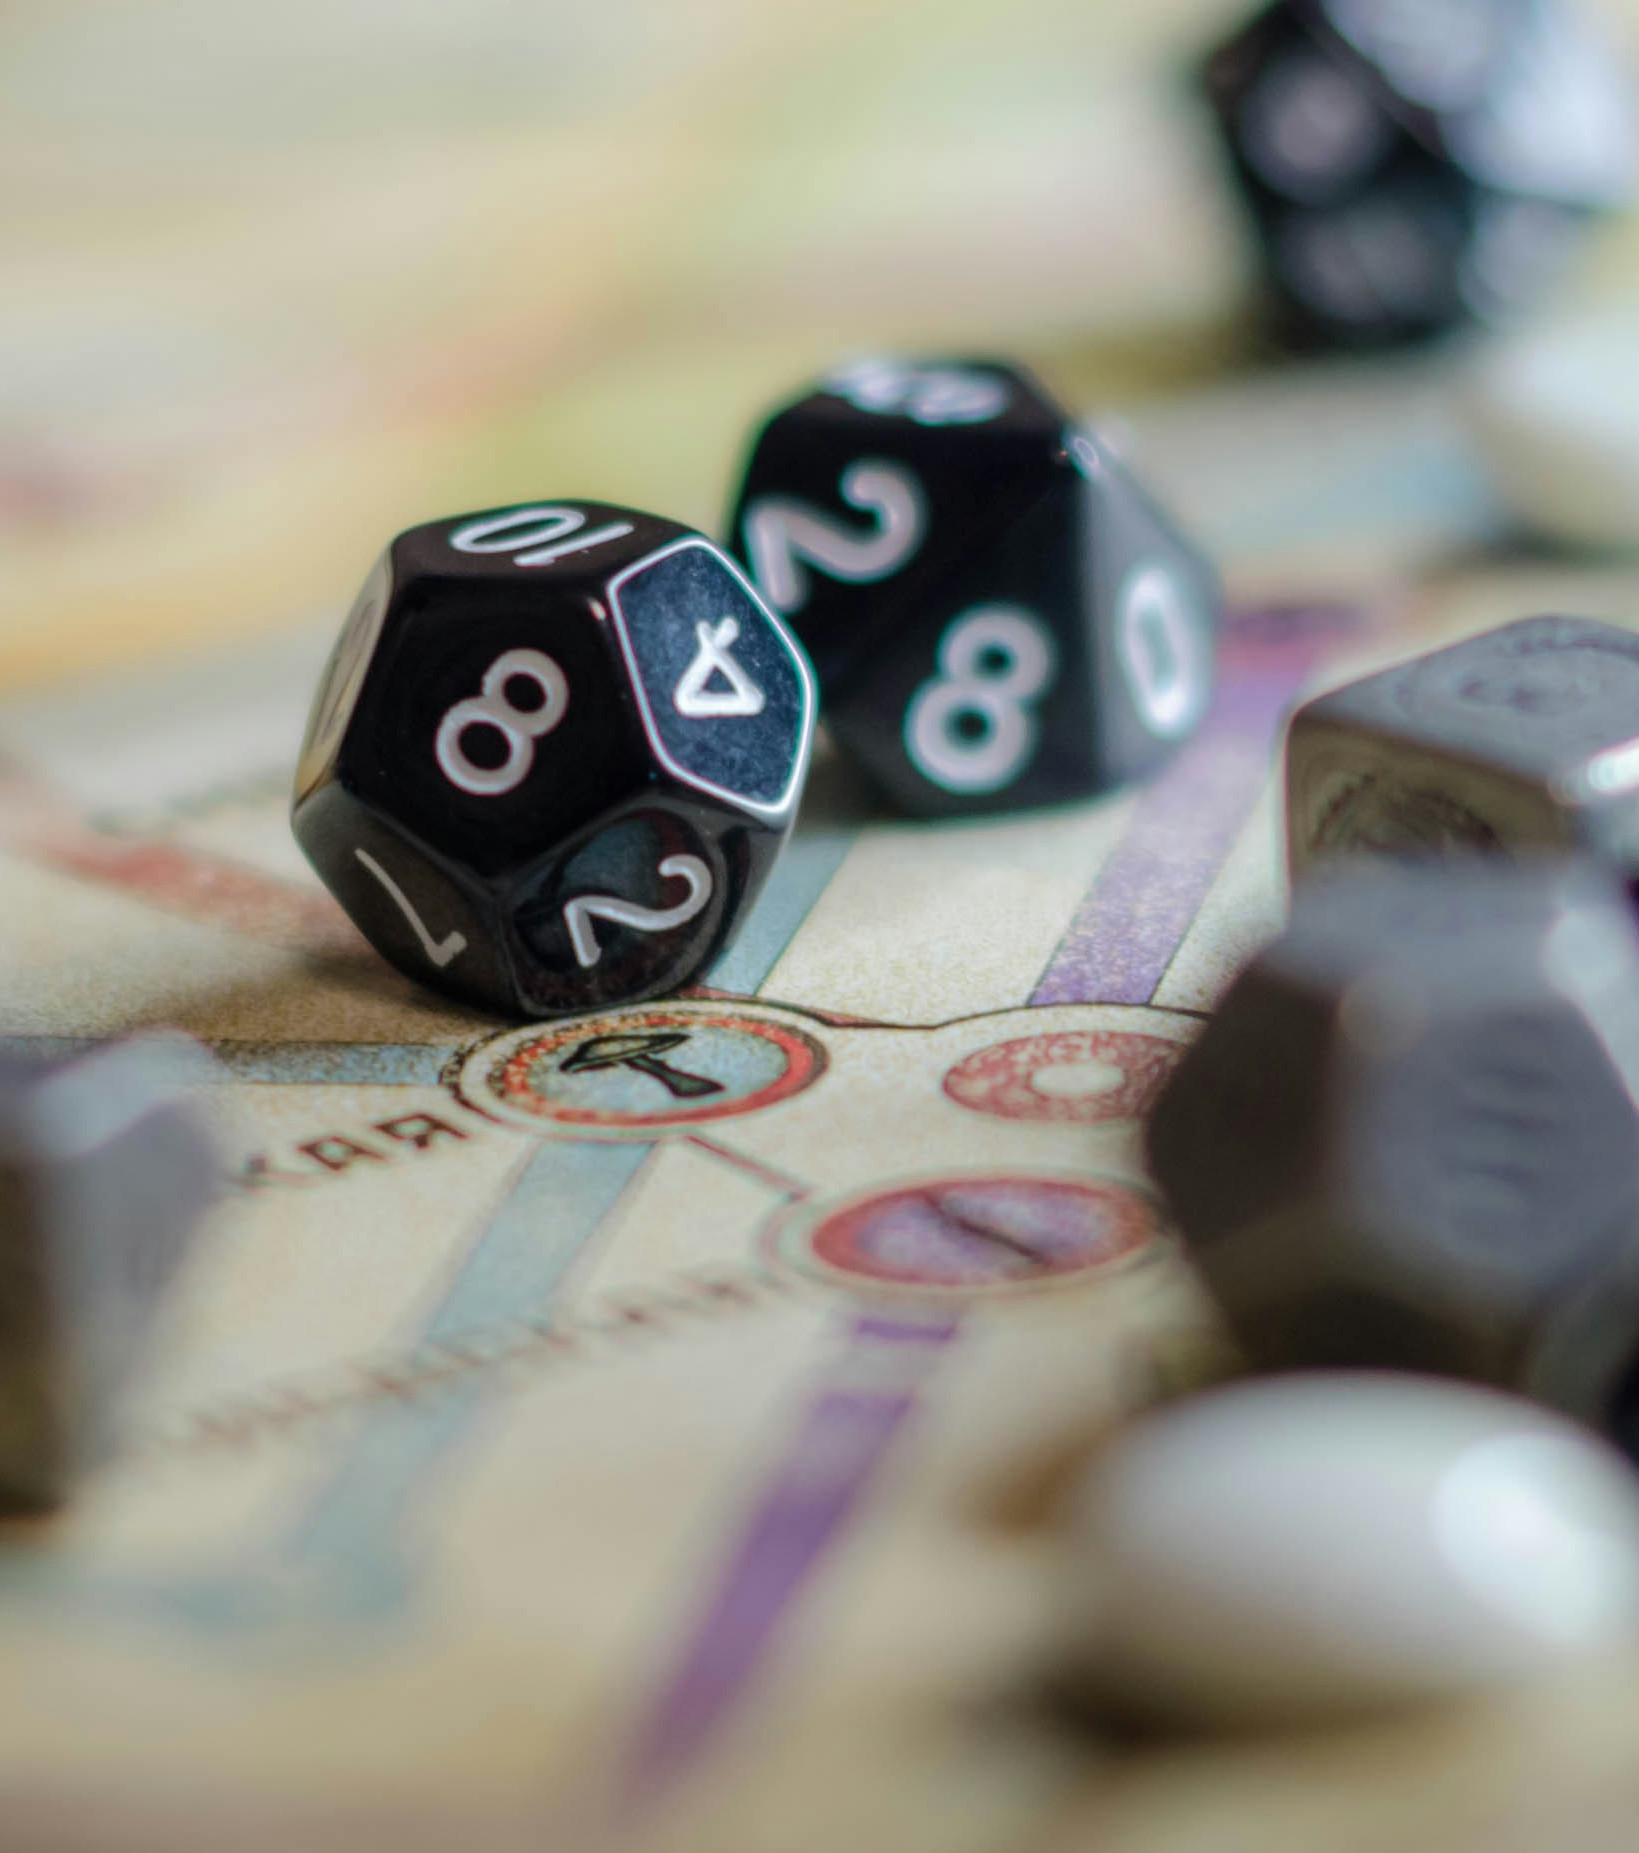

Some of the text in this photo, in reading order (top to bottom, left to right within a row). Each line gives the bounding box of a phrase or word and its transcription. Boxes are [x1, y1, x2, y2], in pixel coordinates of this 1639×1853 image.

[448, 506, 635, 567] 10
[744, 460, 928, 612] 2
[435, 647, 569, 796] 8
[672, 616, 766, 718] 4
[902, 605, 1052, 794] 8
[564, 852, 713, 968] 2
